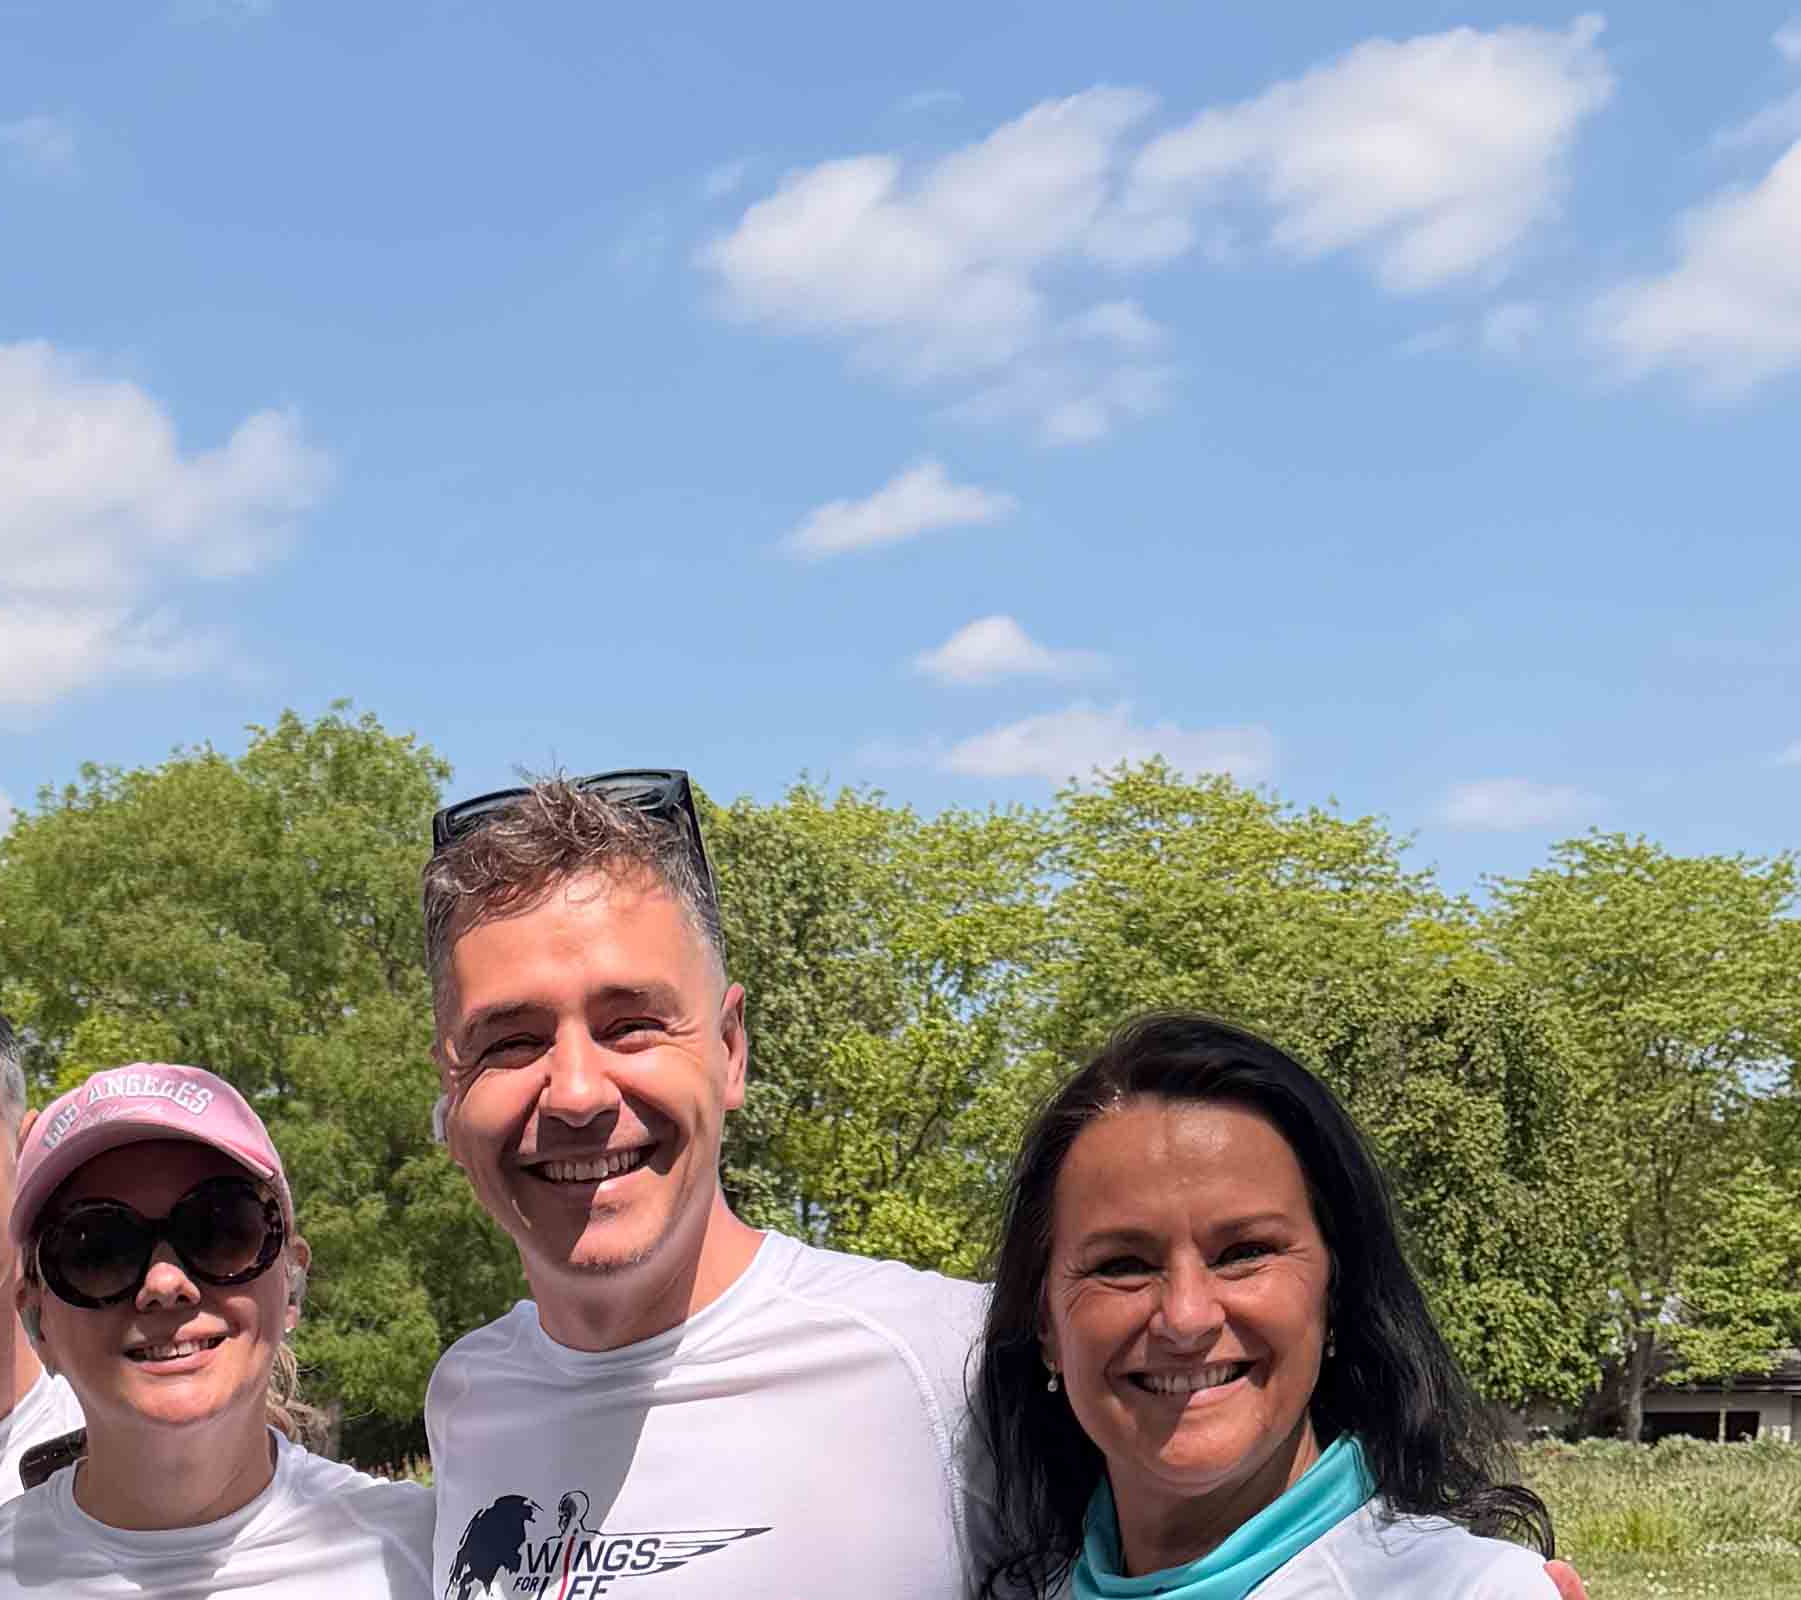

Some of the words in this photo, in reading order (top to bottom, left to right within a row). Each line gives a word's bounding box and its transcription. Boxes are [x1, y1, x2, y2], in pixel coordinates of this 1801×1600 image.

[87, 1072, 216, 1116] ANGELES
[527, 1535, 661, 1572] WINGS
[513, 1576, 539, 1592] FOR
